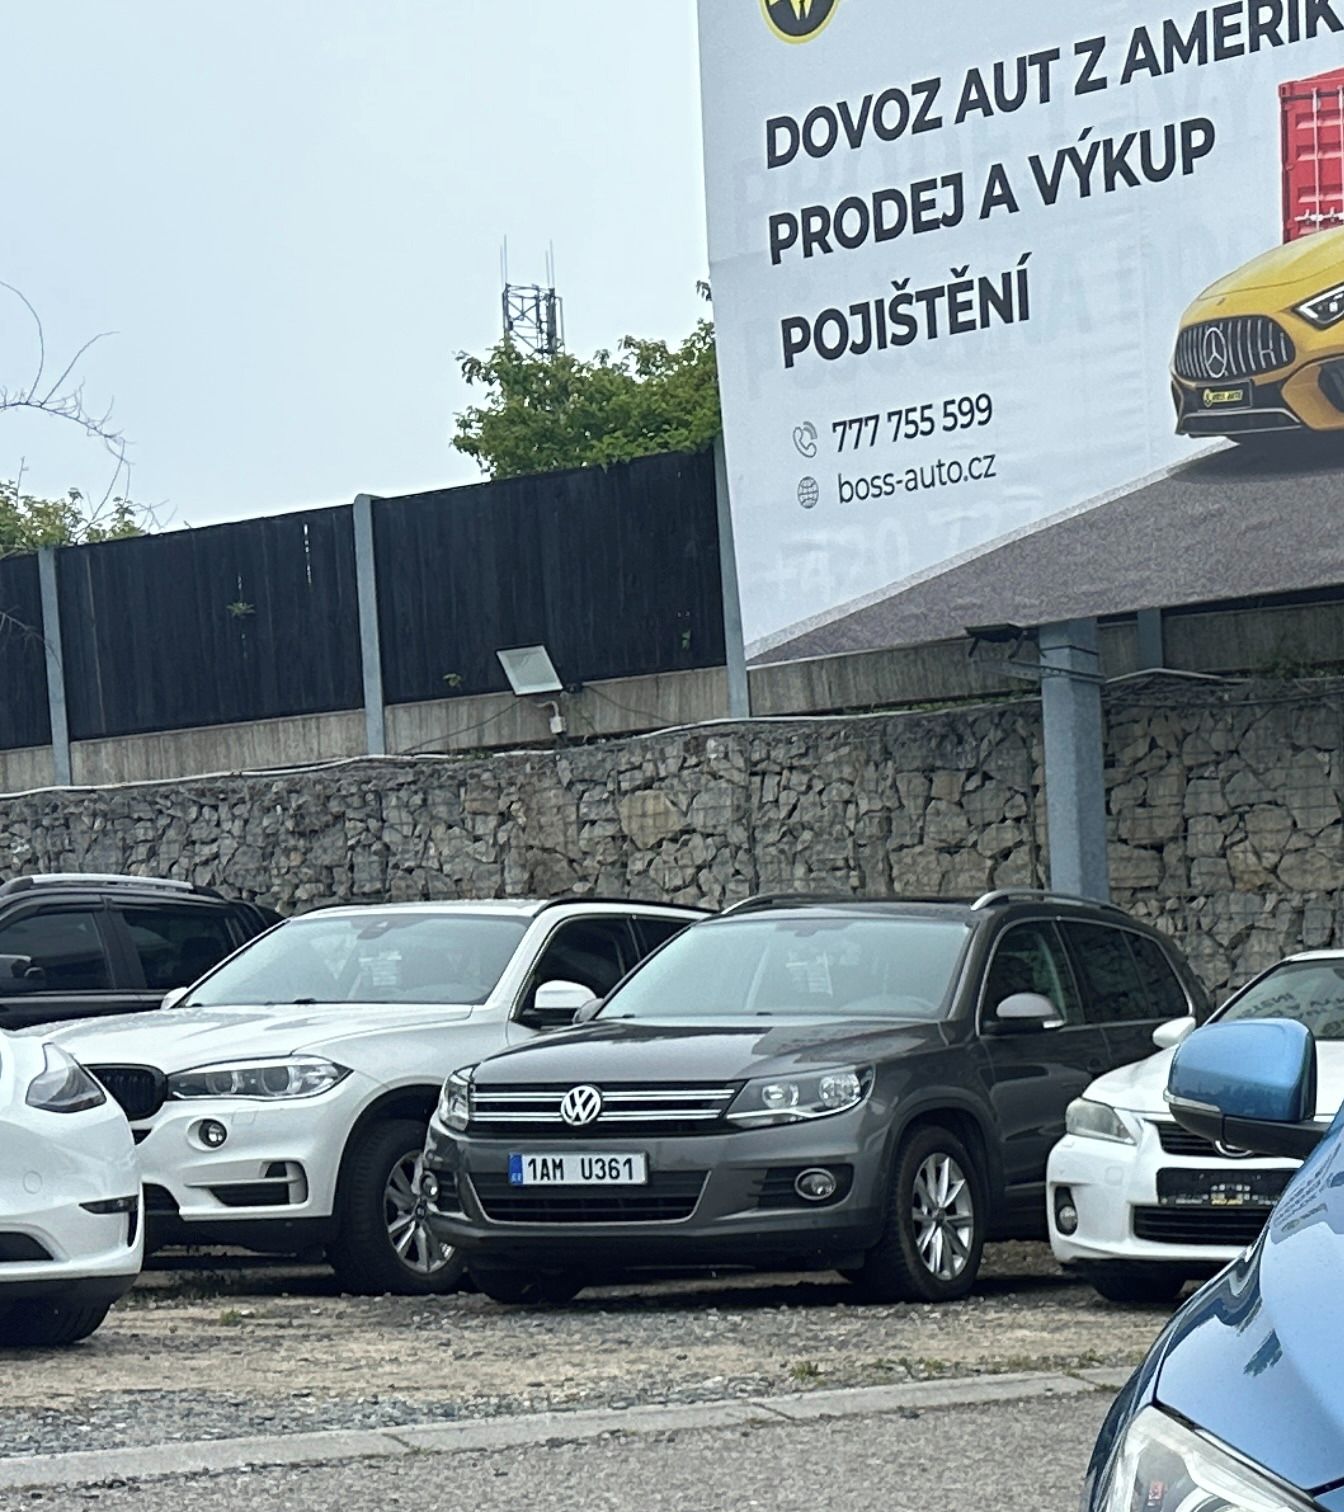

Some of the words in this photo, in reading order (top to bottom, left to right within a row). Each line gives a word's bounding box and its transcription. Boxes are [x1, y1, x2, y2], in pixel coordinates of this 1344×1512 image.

[766, 77, 943, 169] DOVOZ
[954, 47, 1061, 124] AUT
[1074, 36, 1108, 95] Z
[768, 172, 965, 265] PRODEJ
[979, 163, 1020, 220] A
[1028, 117, 1216, 206] VÝKUP
[780, 251, 1032, 369] POJIŠTĚNÍ
[832, 416, 880, 453] 777
[887, 405, 936, 443] 755
[942, 393, 993, 432] 599
[837, 450, 997, 504] boss-auto.cz
[528, 1157, 565, 1181] 1AM
[580, 1157, 633, 1181] U361
